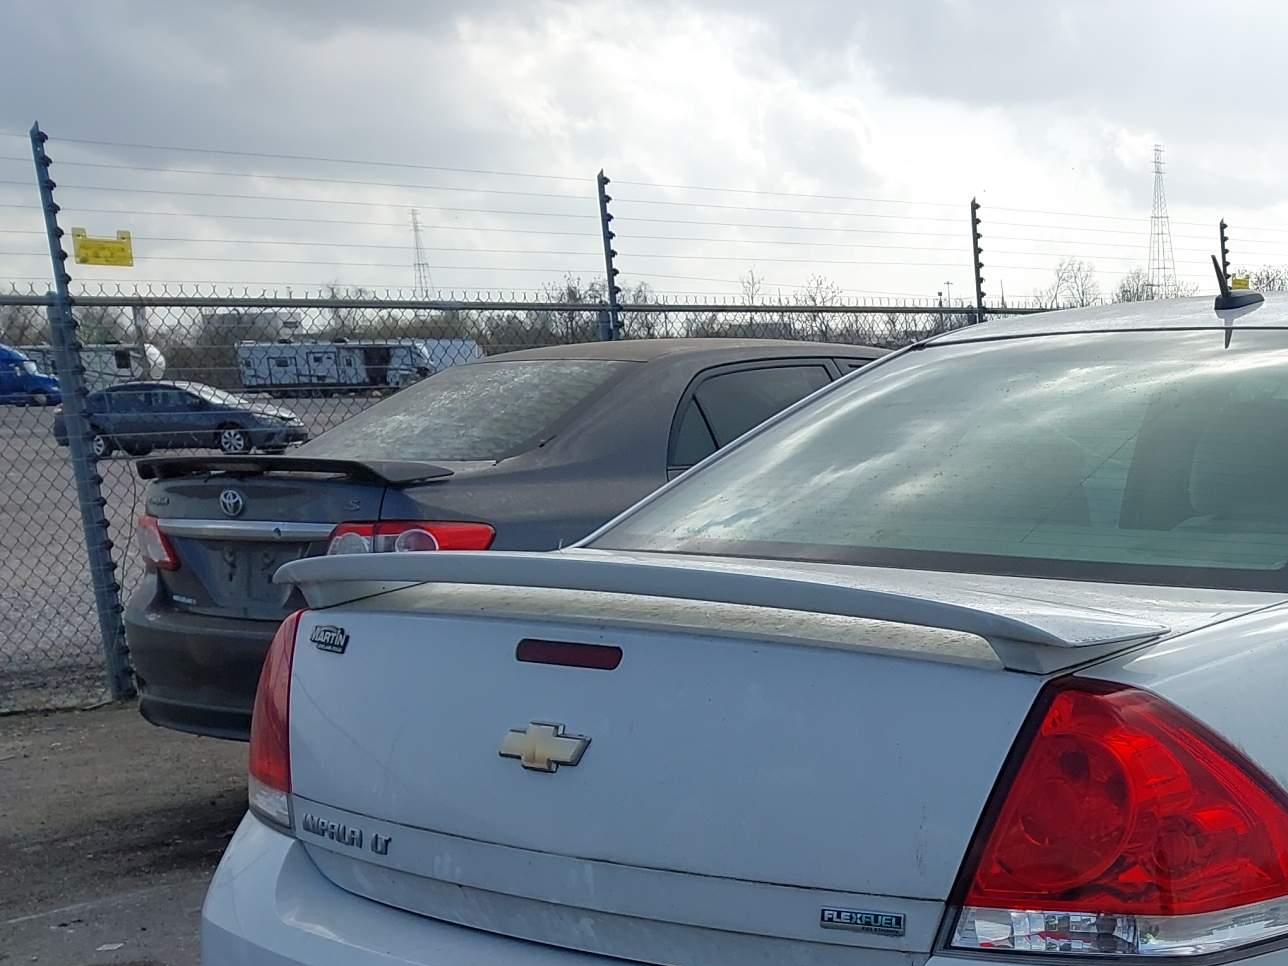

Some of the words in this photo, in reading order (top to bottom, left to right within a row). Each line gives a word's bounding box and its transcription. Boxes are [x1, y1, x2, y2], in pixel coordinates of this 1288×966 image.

[303, 813, 363, 849] IMPALA
[371, 832, 392, 855] LT
[823, 909, 902, 929] FLEXFUEL
